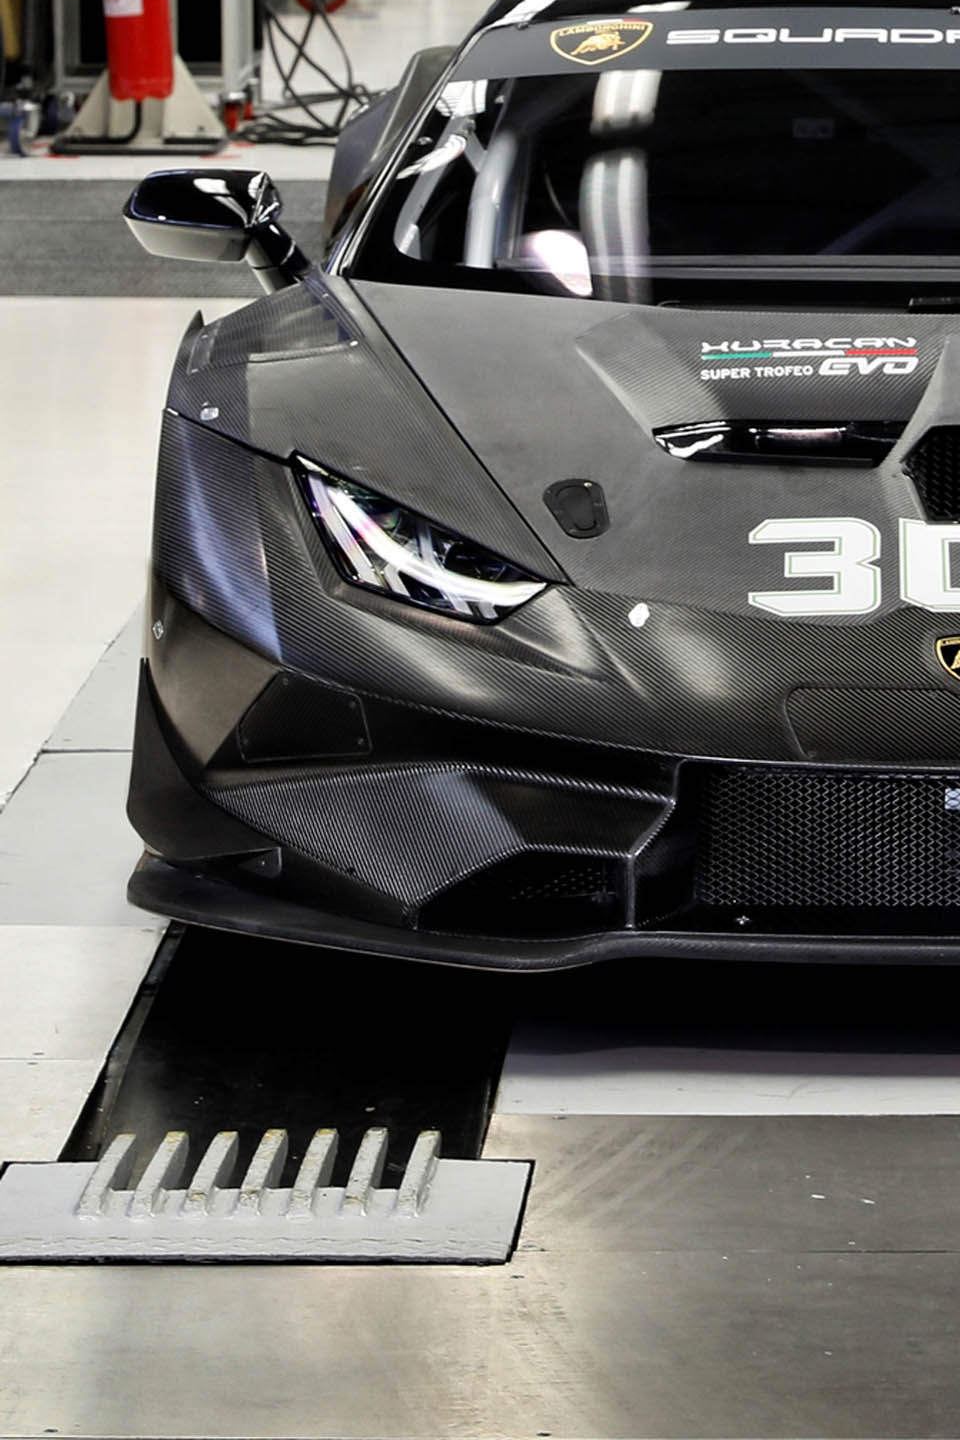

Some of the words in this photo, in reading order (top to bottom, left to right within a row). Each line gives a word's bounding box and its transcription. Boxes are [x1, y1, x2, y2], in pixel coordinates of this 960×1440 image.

[701, 368, 751, 381] SUPER
[754, 364, 814, 378] TROFEO
[818, 356, 919, 376] EVO
